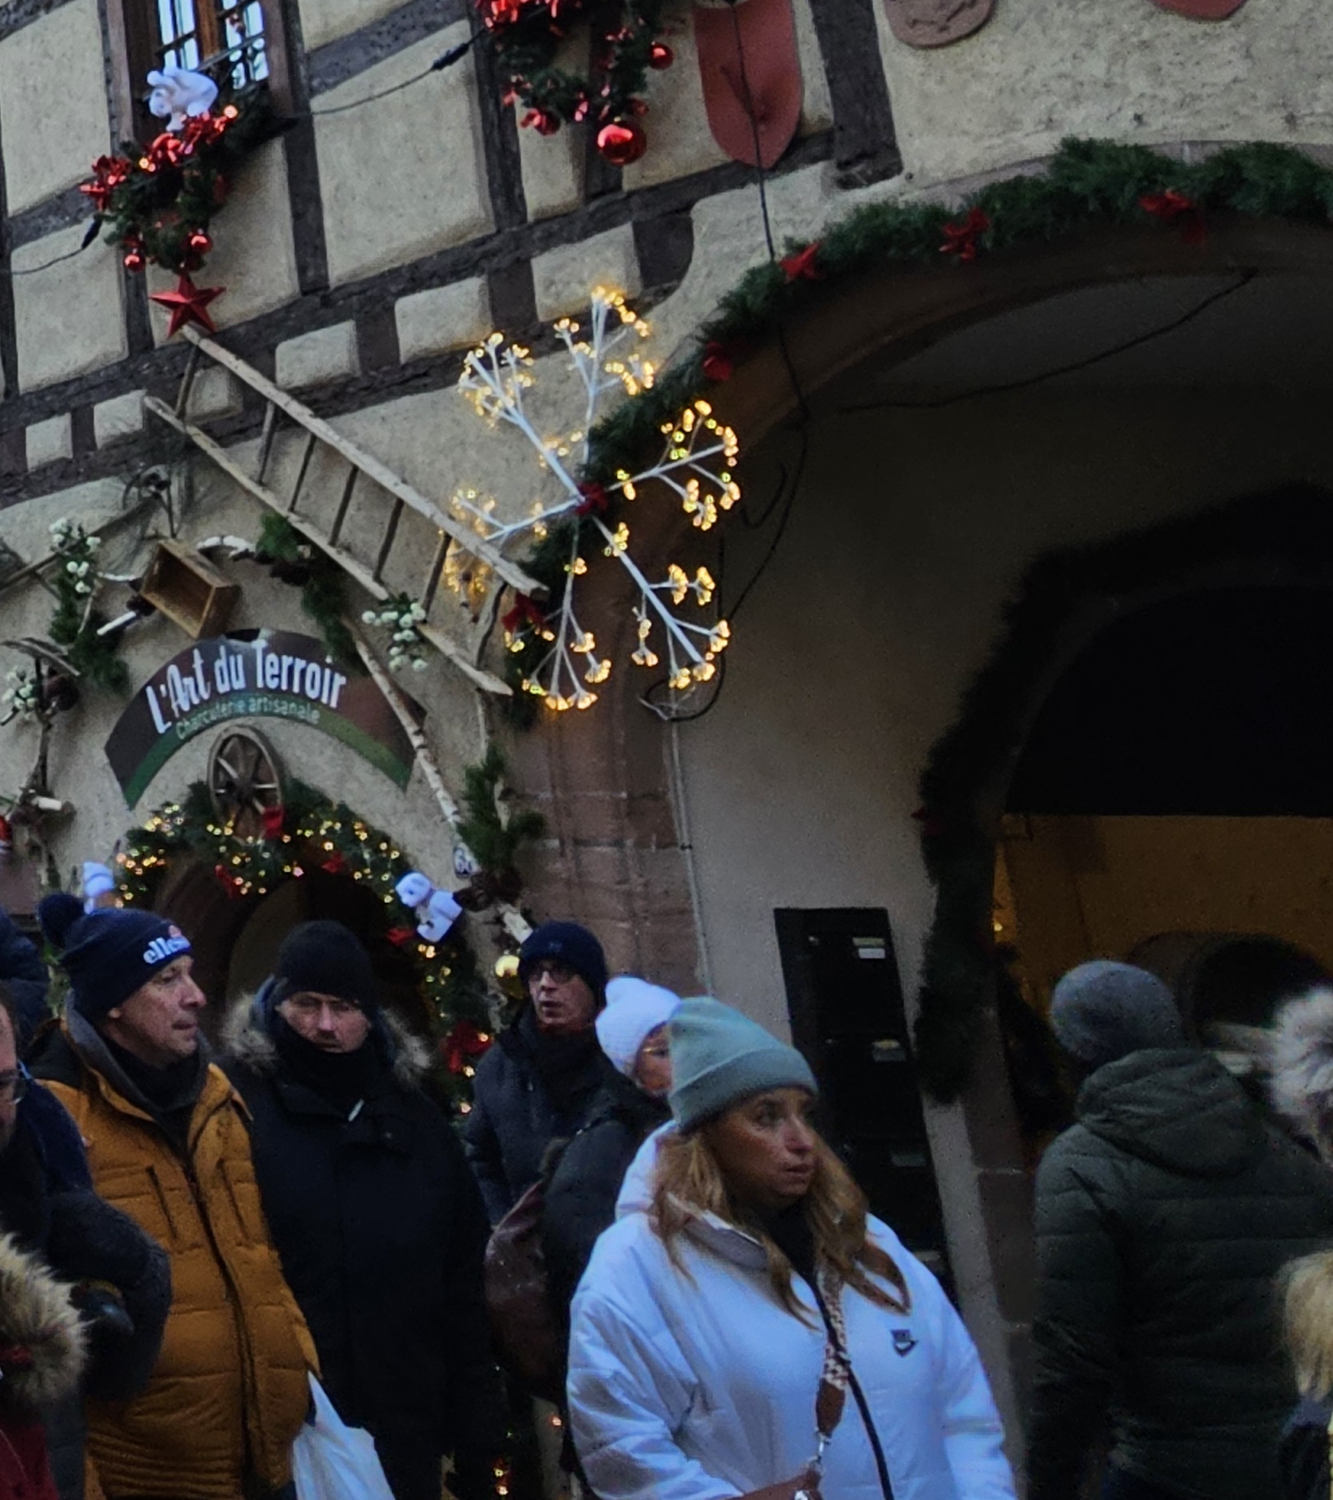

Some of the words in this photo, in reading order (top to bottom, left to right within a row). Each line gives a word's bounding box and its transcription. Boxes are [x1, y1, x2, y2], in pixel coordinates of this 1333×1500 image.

[145, 648, 212, 734] L'Art
[214, 644, 247, 694] du
[251, 639, 346, 708] Terroir
[248, 697, 321, 725] artisanale
